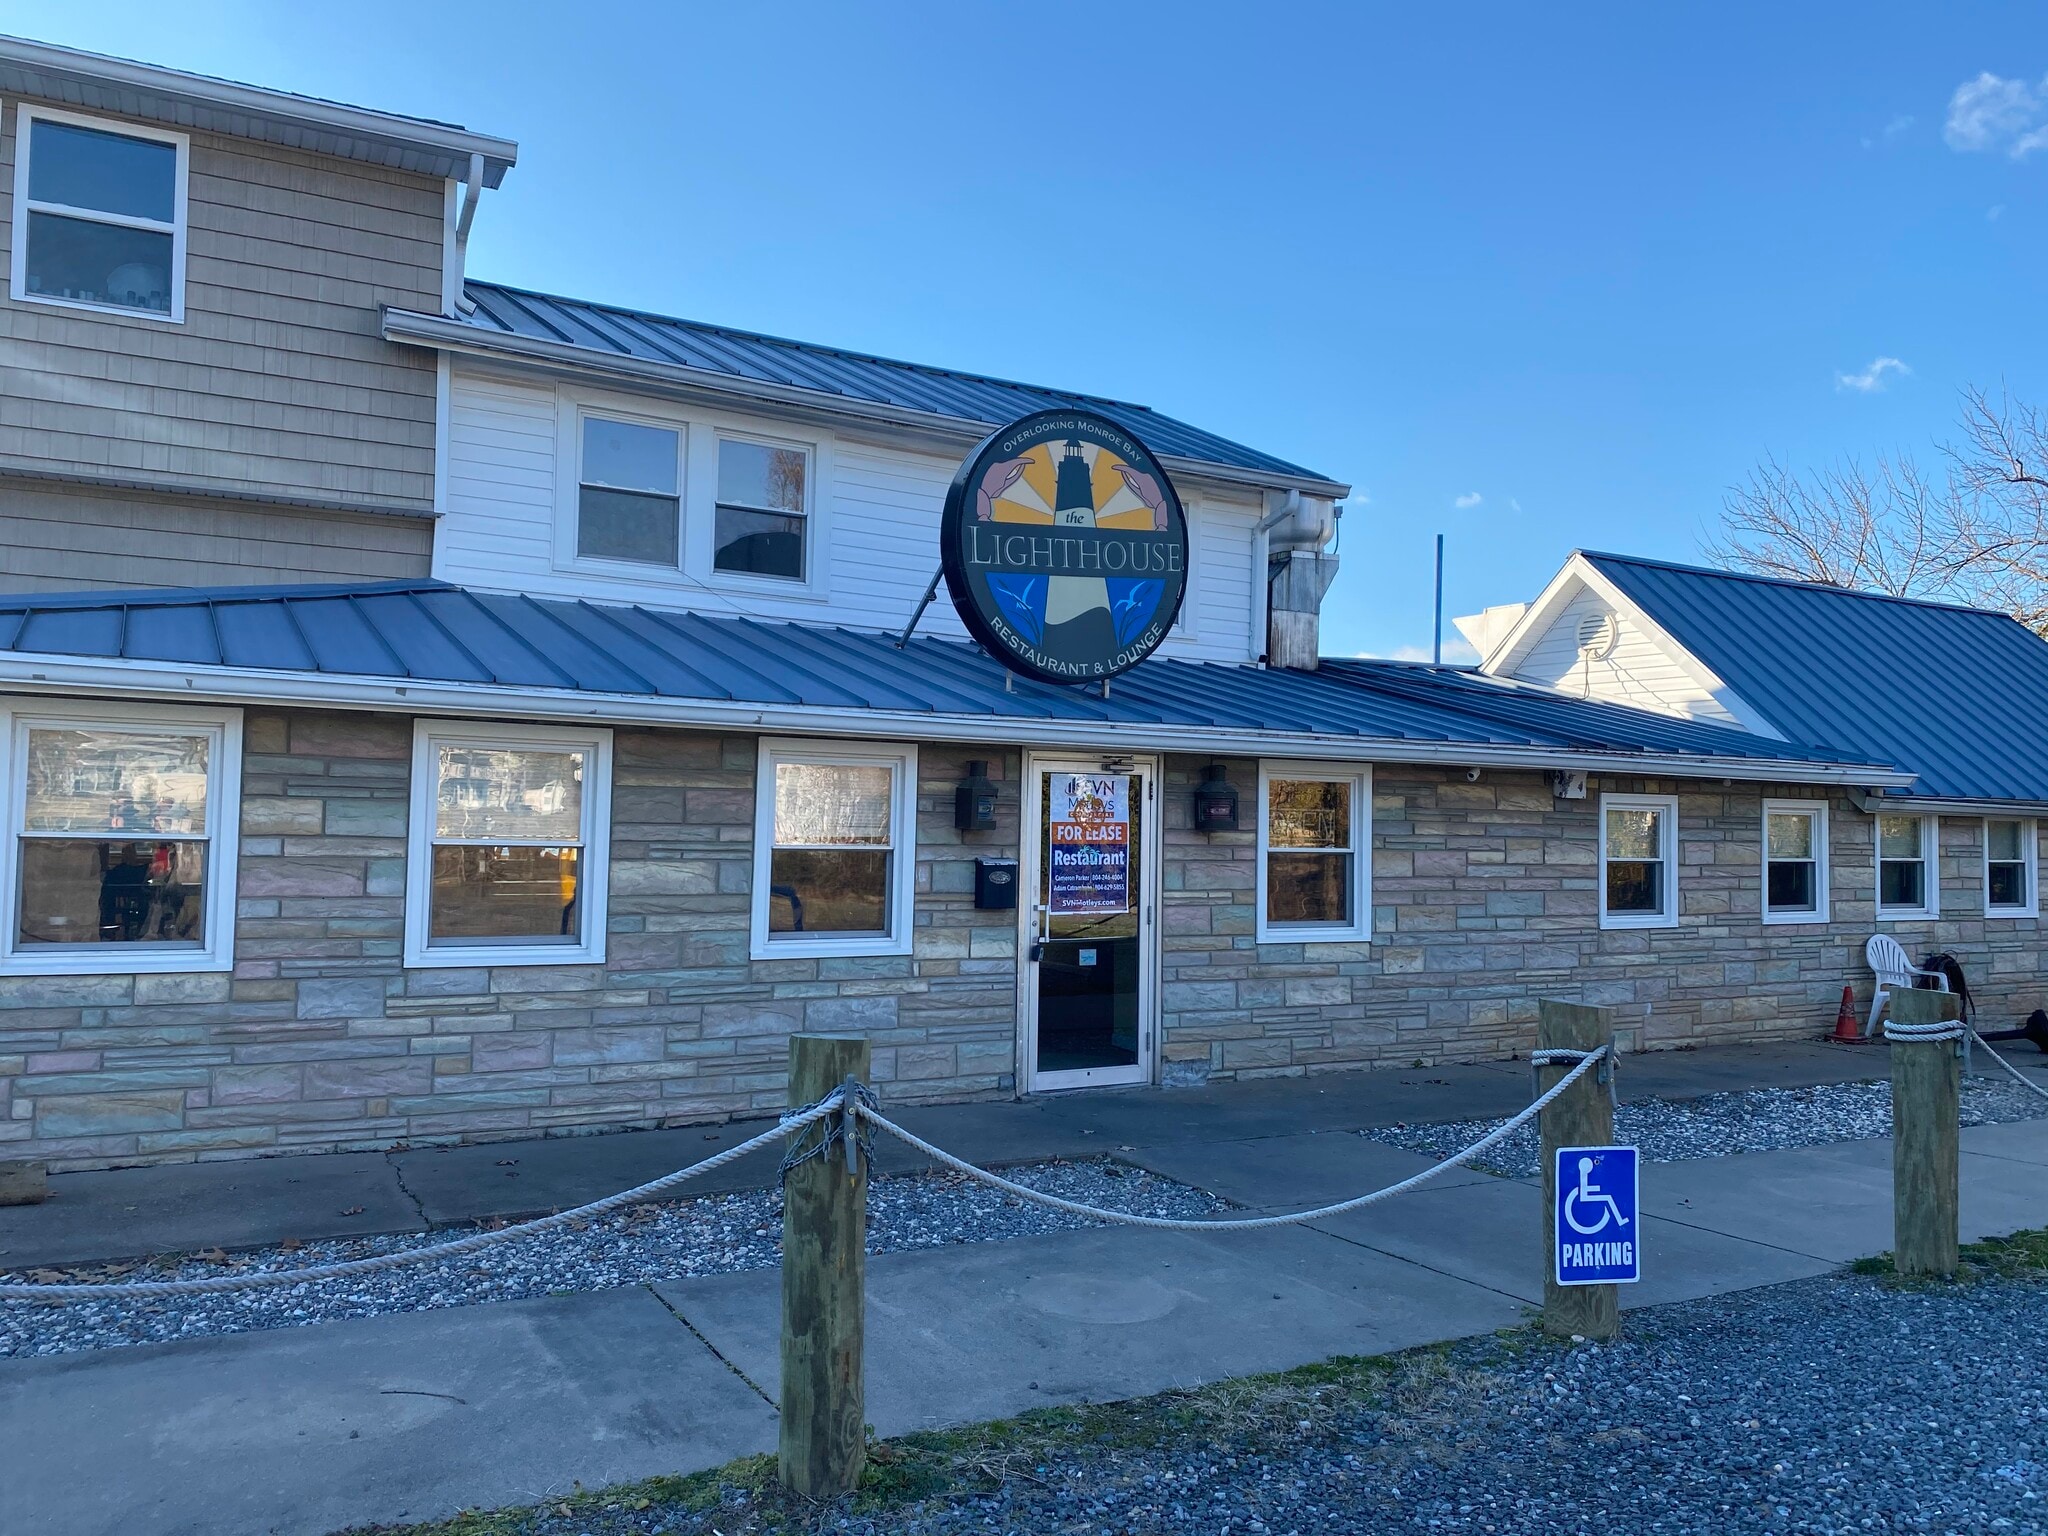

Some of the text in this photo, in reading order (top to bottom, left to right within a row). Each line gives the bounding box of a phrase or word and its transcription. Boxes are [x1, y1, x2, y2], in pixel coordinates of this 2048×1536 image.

[1003, 421, 1142, 462] OVERLOOKING MONROE BAY
[1065, 511, 1085, 524] the
[968, 525, 1181, 572] LIGHTHOUSE
[990, 616, 1163, 675] RESTAURANT & LOUNGE
[1057, 825, 1122, 841] FOR LEASE
[1054, 849, 1125, 866] Restaurant
[1562, 1241, 1633, 1268] PARKING
